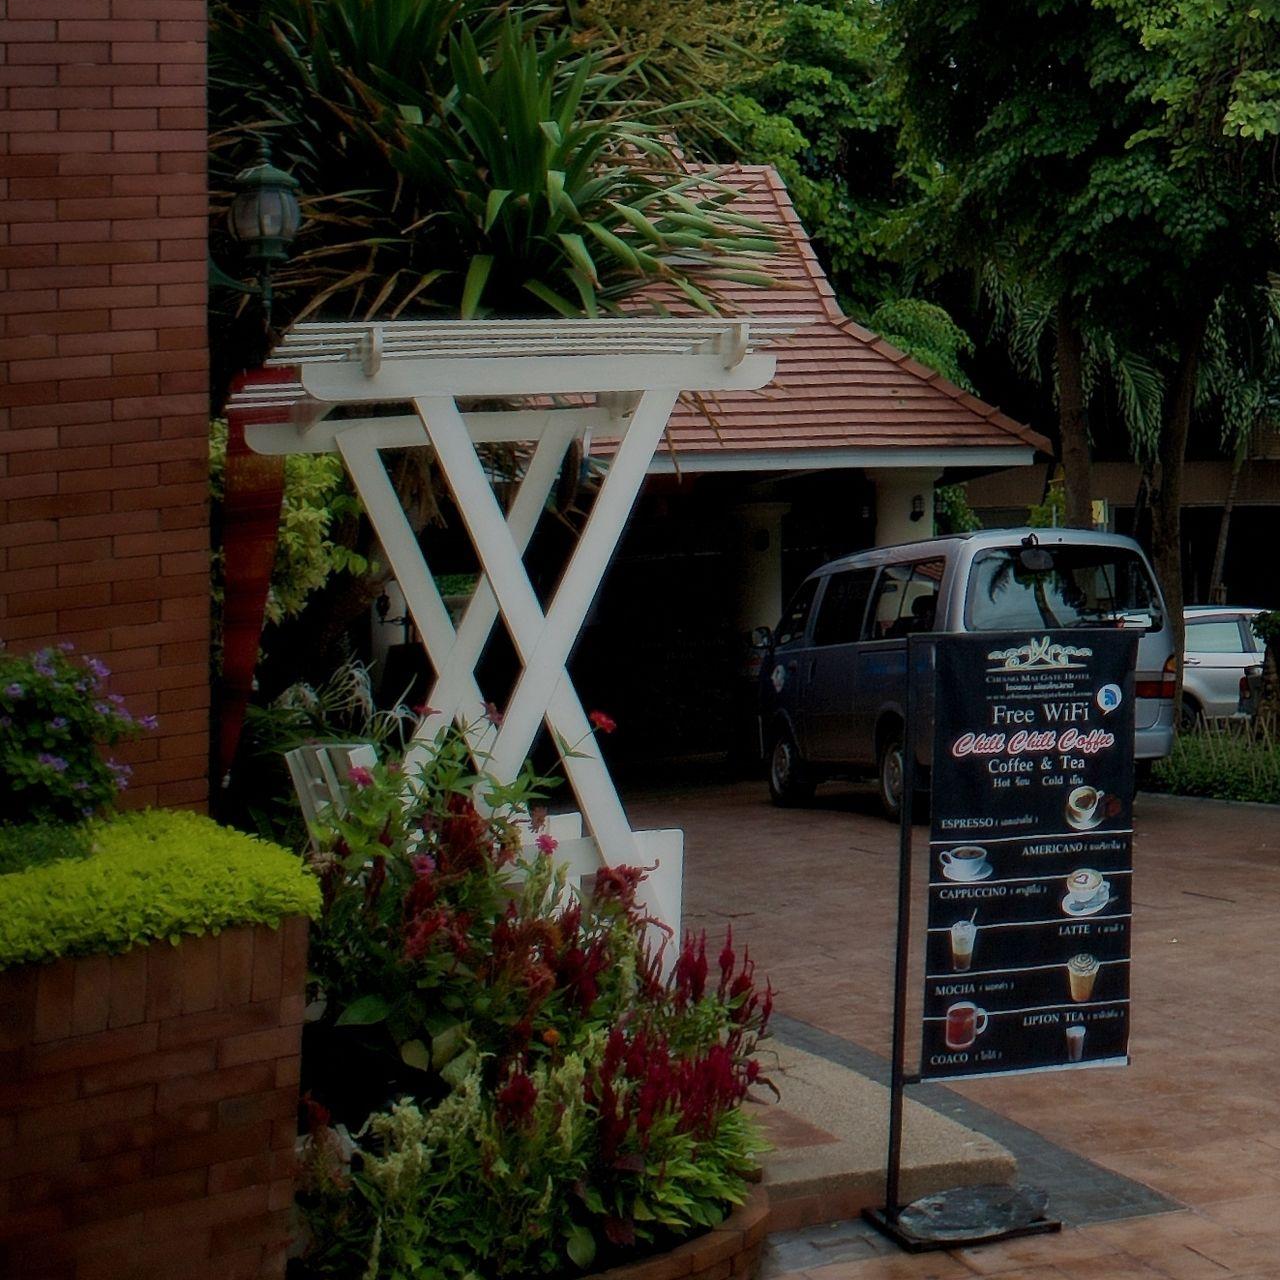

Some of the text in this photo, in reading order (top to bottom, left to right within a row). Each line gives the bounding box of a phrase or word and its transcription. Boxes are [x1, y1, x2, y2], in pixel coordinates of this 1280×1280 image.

[993, 702, 1090, 724] Free WiFi
[952, 727, 1115, 757] Chill Chill Coffee
[988, 754, 1086, 774] Coffee & Tea
[993, 777, 1011, 788] Hot
[1042, 775, 1064, 786] Cold
[940, 816, 994, 829] ESPRESSO
[1022, 841, 1083, 856] AMERICANO
[939, 886, 1007, 899] CAPPUCCINO
[1058, 924, 1091, 937] LATTE
[935, 983, 975, 996] MOCHA
[1023, 1014, 1060, 1026] LIPTON
[1064, 1012, 1084, 1023] TEA
[930, 1053, 969, 1066] COACO
